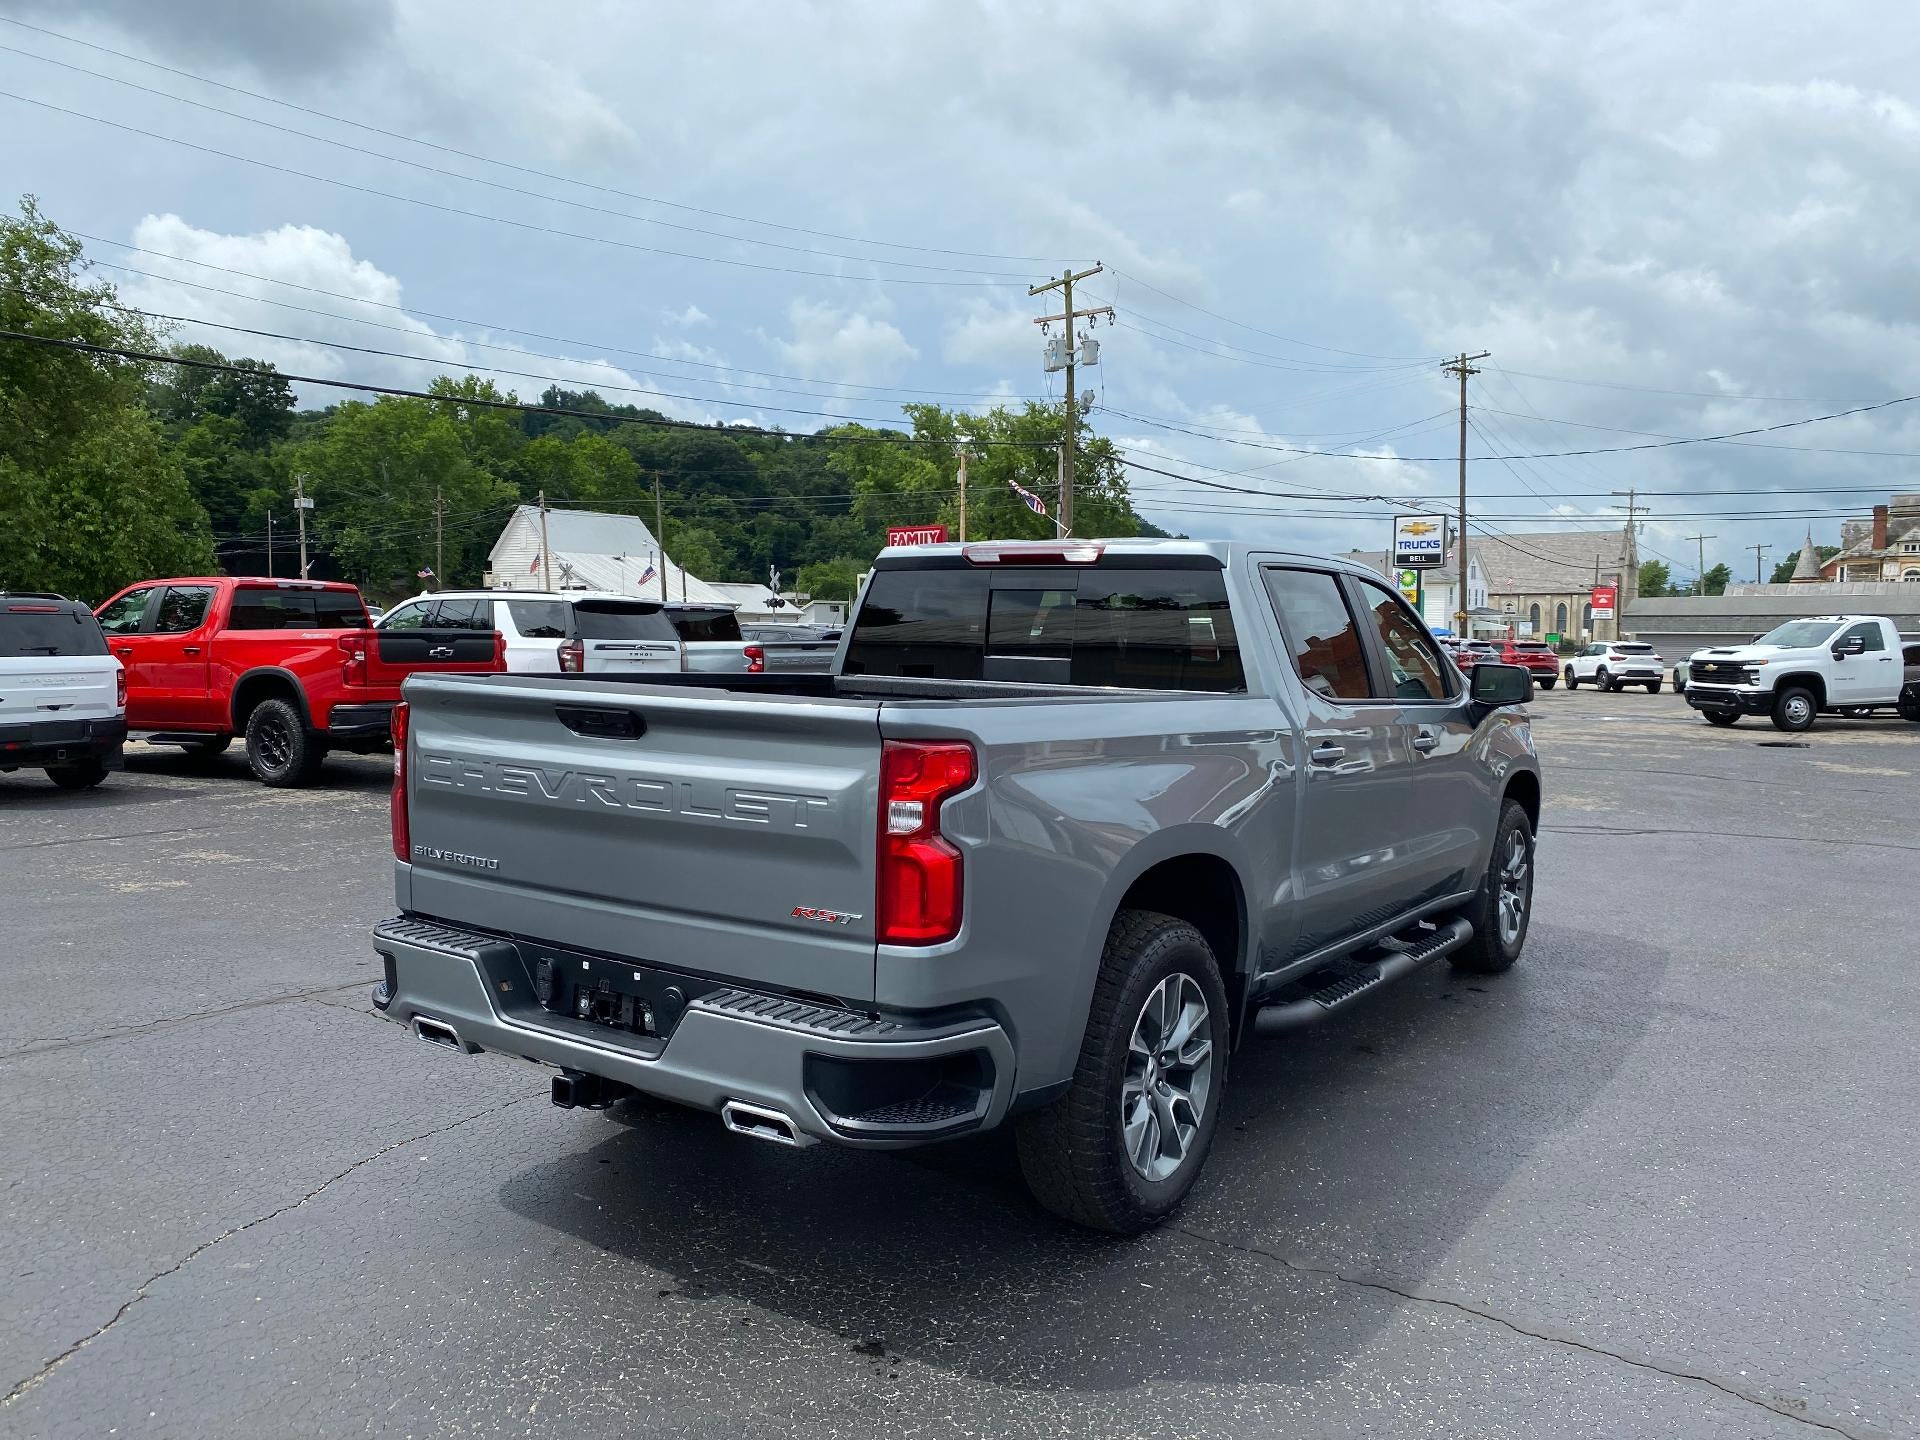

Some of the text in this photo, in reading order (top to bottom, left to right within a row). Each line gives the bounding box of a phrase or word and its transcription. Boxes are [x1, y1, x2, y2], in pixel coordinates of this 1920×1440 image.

[890, 530, 940, 547] FAMILY
[1398, 540, 1440, 549] TRUCKS
[423, 754, 829, 828] CHEVROLET
[414, 845, 499, 869] SILVERADO
[791, 906, 863, 924] RST
